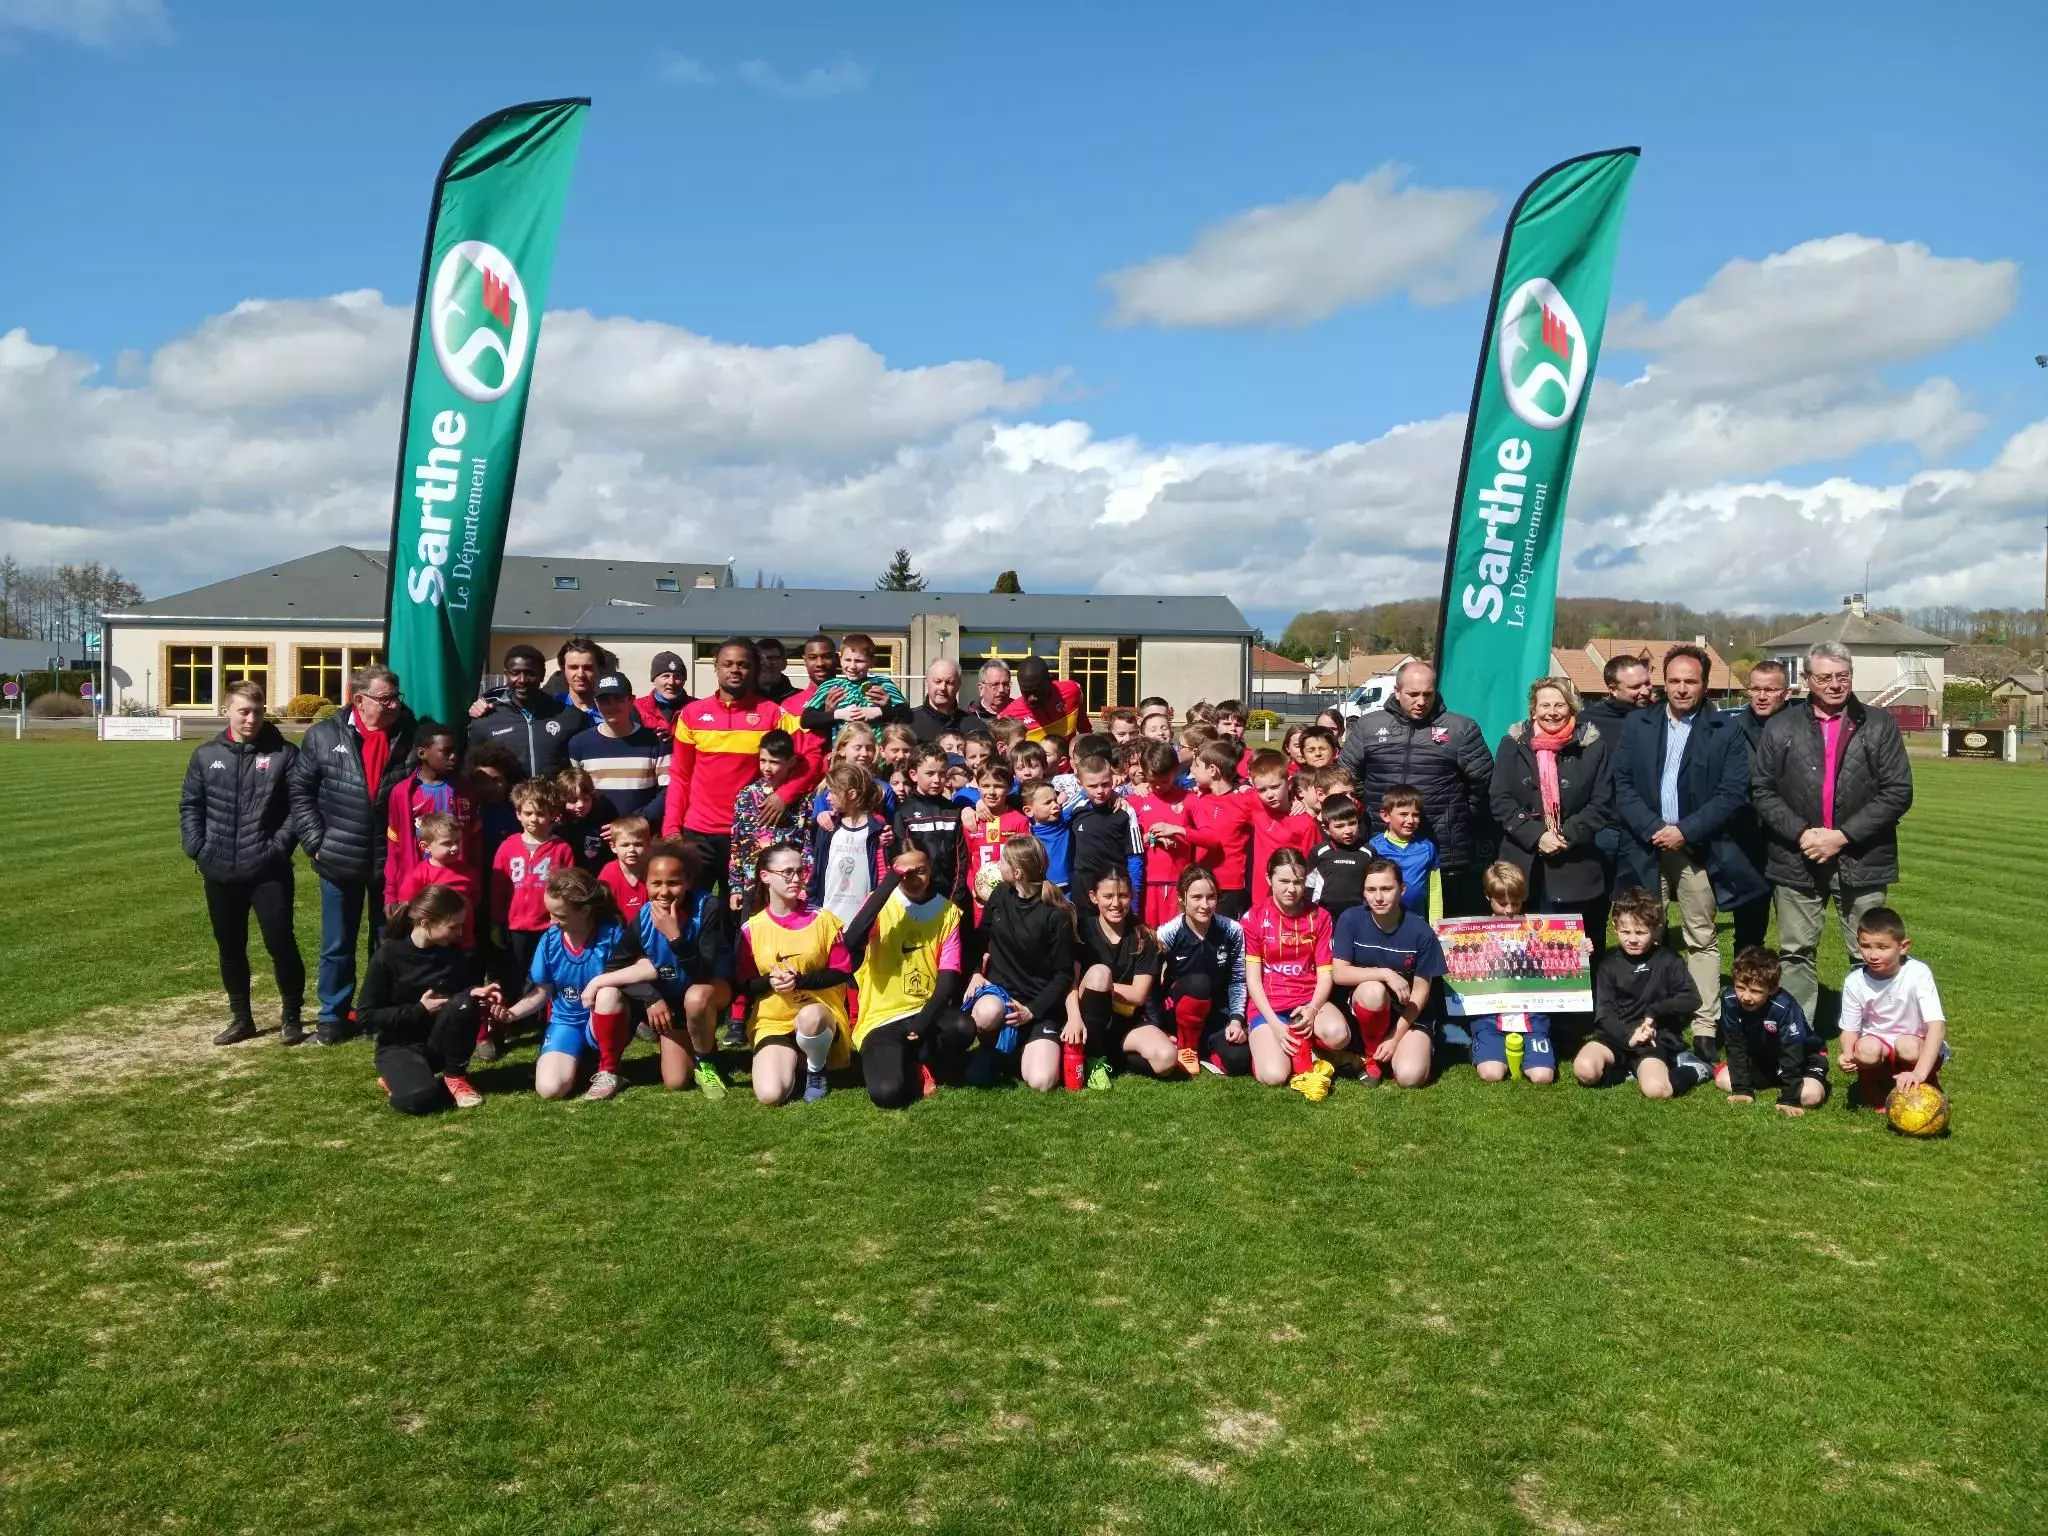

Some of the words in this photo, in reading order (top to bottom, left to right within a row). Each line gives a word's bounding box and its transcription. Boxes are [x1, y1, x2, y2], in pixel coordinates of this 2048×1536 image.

[408, 410, 467, 608] Sarthe
[452, 457, 488, 579] Département
[1462, 438, 1532, 624] Sarthe
[1511, 481, 1549, 600] Département
[449, 582, 468, 612] Le
[1507, 604, 1524, 630] Le
[1530, 1038, 1549, 1053] 10
